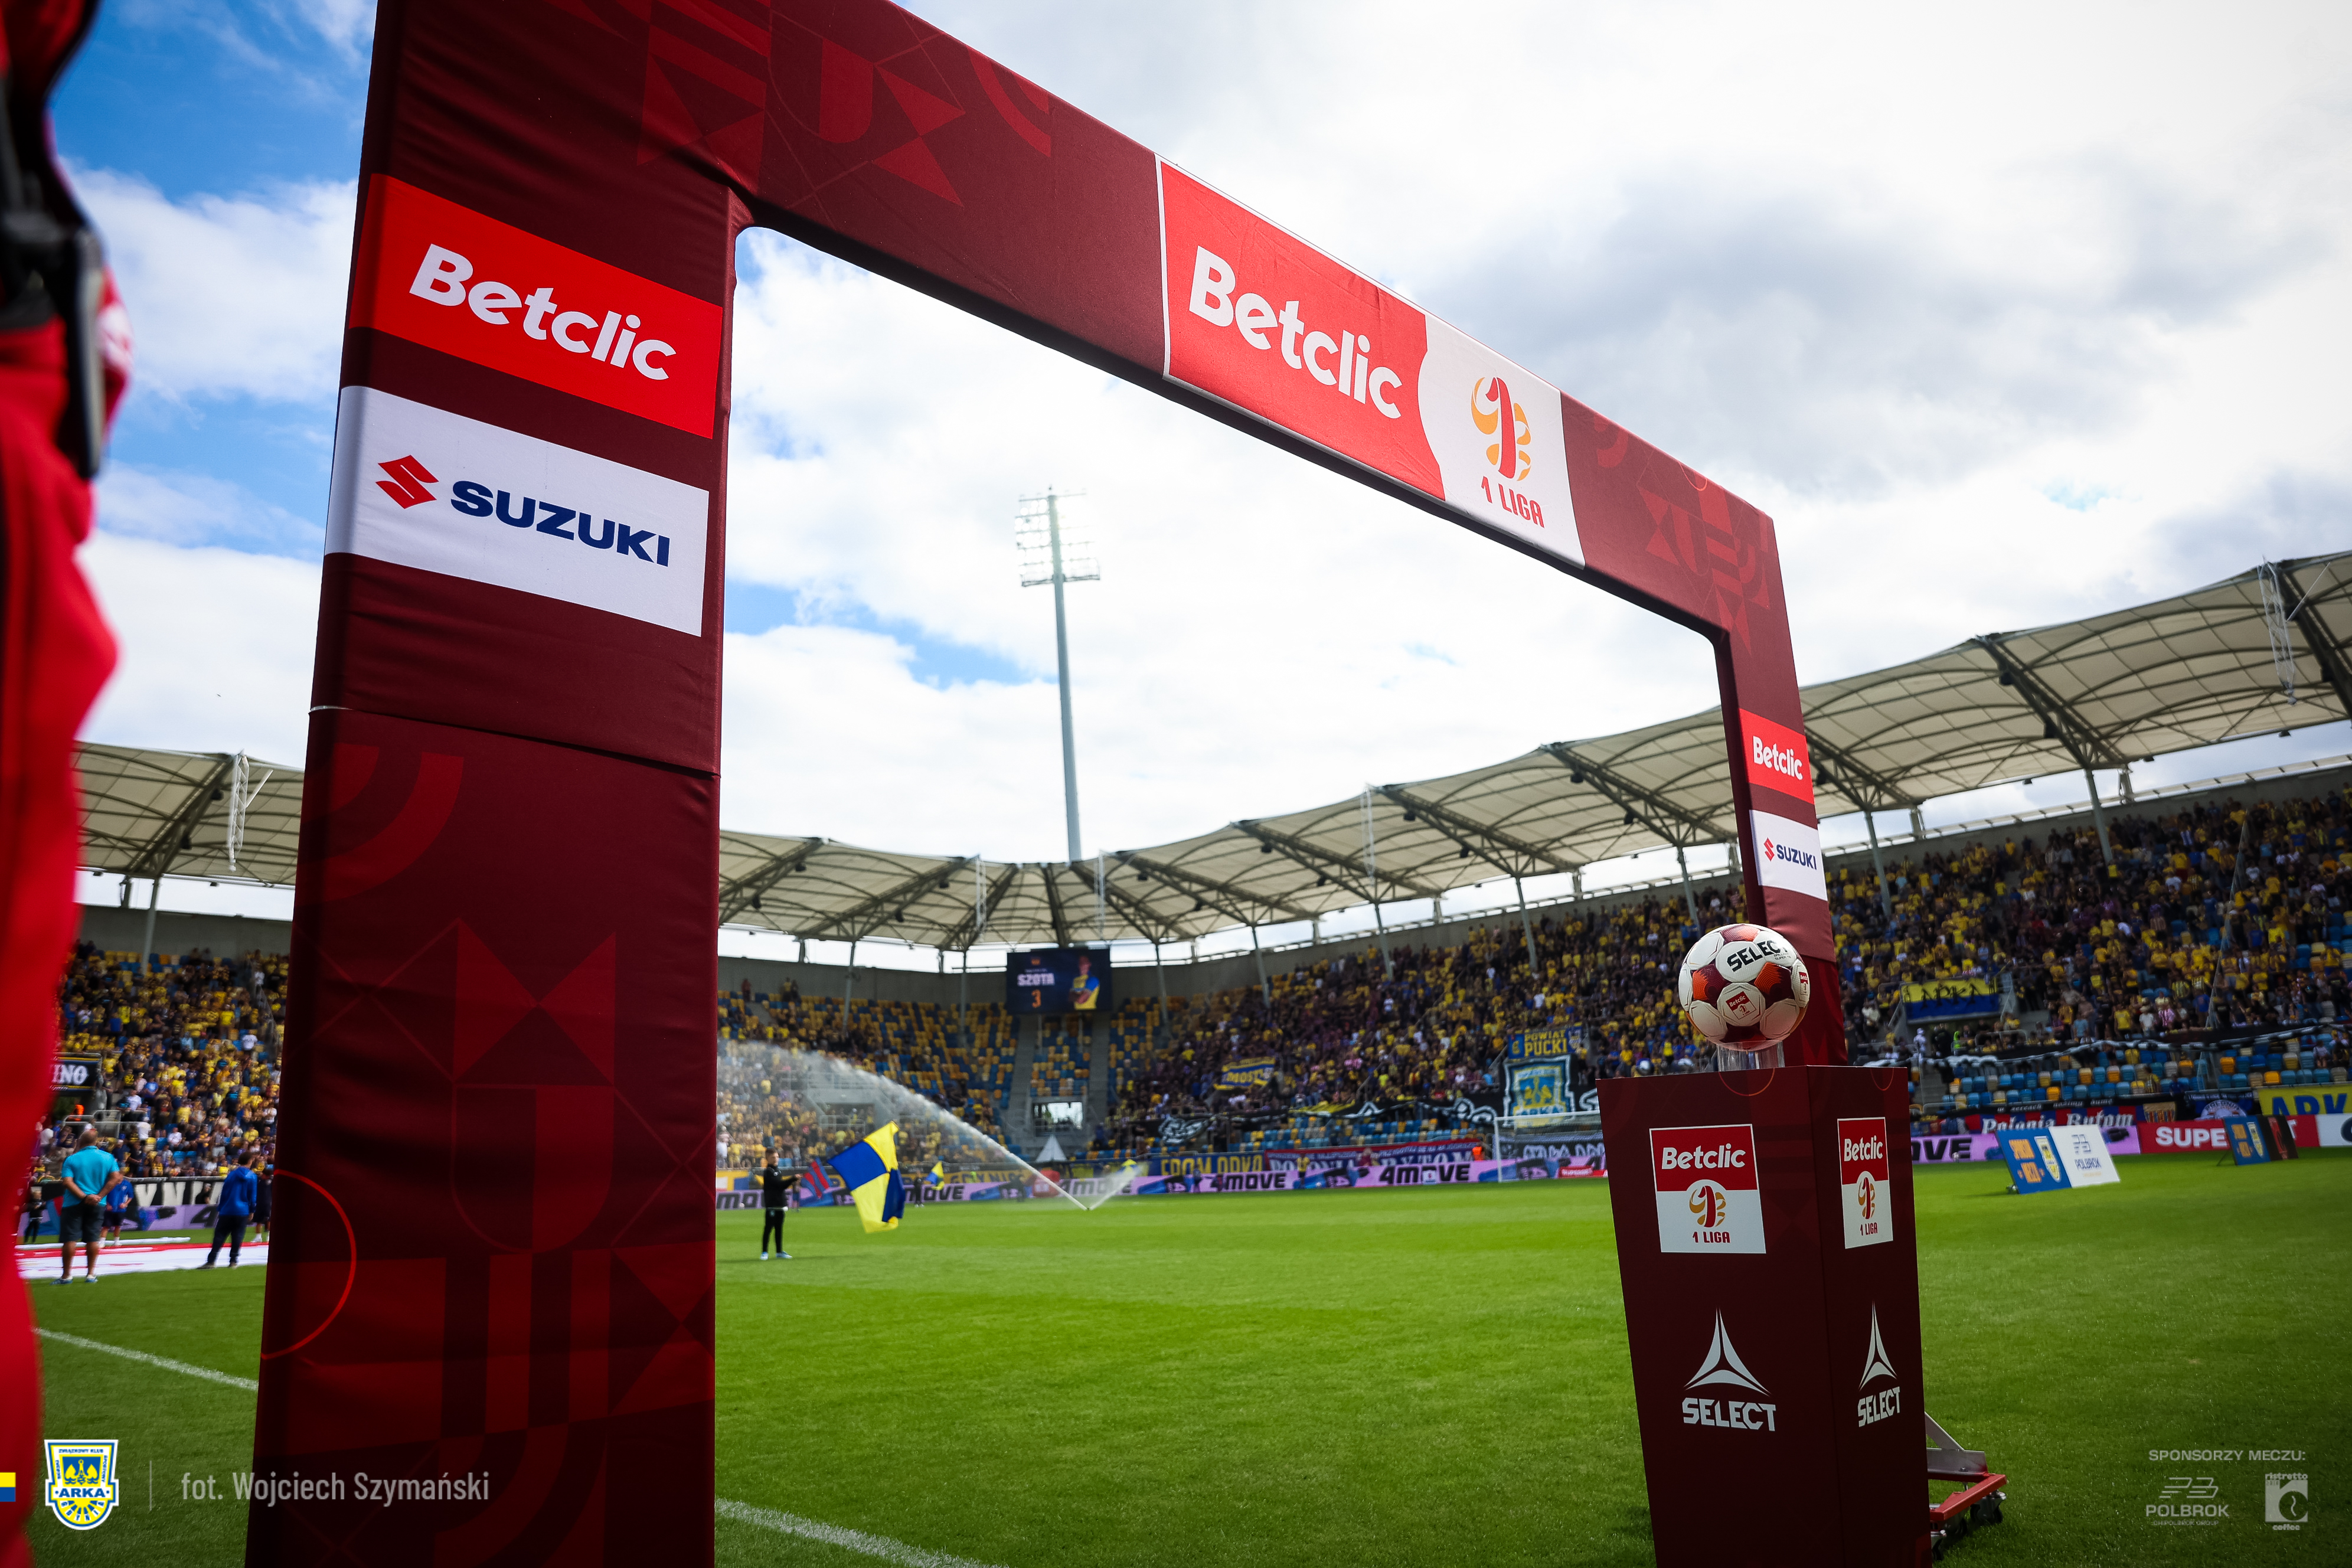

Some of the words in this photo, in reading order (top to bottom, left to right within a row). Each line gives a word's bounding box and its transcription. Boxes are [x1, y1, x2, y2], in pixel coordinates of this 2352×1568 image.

[409, 243, 677, 380] Betclic
[1188, 245, 1403, 419] Betclic
[1481, 475, 1492, 503] 1
[1498, 483, 1544, 528] LIGA
[450, 480, 670, 567] SUZUKI
[1753, 735, 1803, 780] Betclic
[1776, 844, 1817, 870] SUZUKI
[1031, 989, 1041, 1008] 3
[1729, 995, 1746, 1007] Betclic
[1524, 1029, 1566, 1041] POWIAT
[1524, 1038, 1567, 1057] PUCKI
[51, 1064, 89, 1085] INO
[1981, 1114, 2055, 1134] Polonia
[1661, 1143, 1746, 1170] Betclic
[1844, 1135, 1883, 1162] Betclic
[1692, 1231, 1698, 1243] 1
[1703, 1231, 1730, 1243] LIGA
[1860, 1224, 1864, 1236] 1
[1865, 1222, 1877, 1236] LIGA
[1682, 1397, 1776, 1432] SELECT
[1857, 1386, 1900, 1427] SELECT
